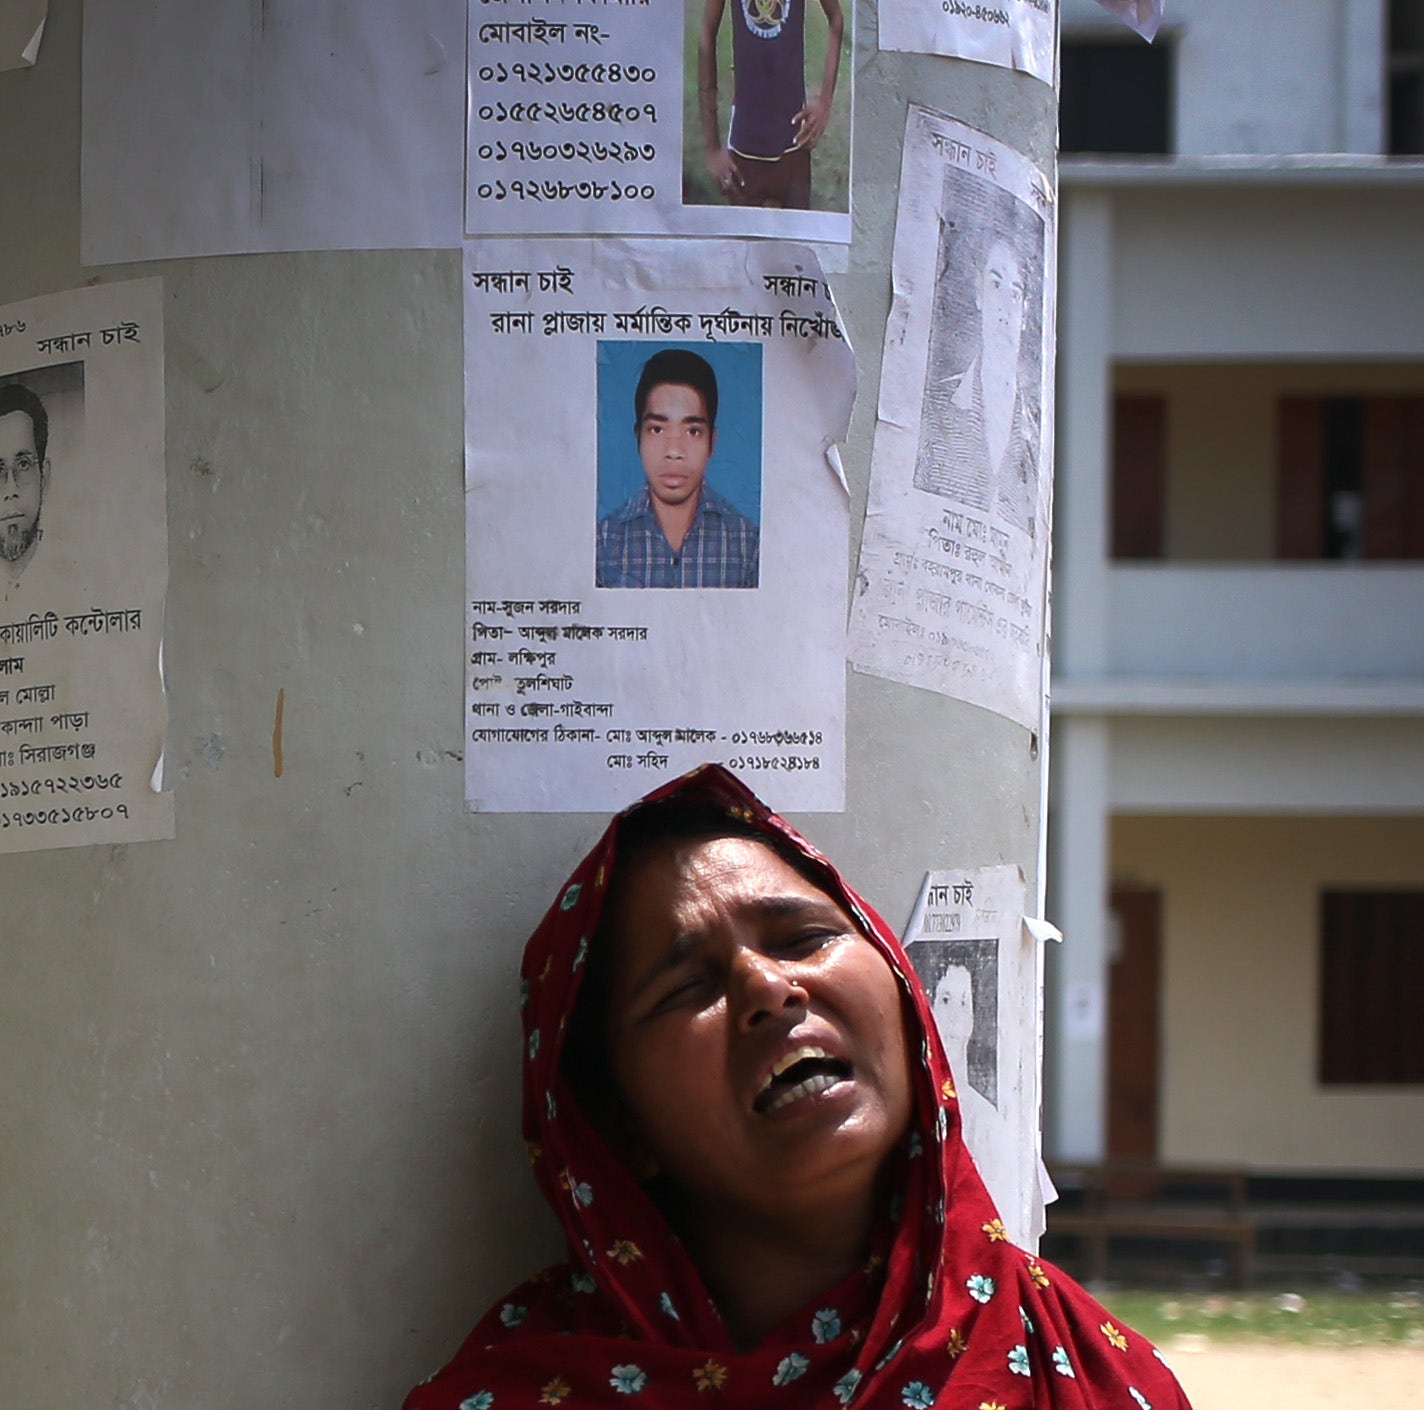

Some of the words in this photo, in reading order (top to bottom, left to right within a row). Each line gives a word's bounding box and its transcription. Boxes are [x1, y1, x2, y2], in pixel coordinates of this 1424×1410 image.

[478, 16, 567, 45] মোবাইল
[573, 23, 610, 45] নং-
[478, 62, 657, 85] ০১৭২১৩৫৫৪৩০
[478, 101, 658, 125] ০১৫৫২৬৫৪৫০৭
[478, 141, 656, 164] ০১৭৬০৩২৬২৯৩
[478, 180, 655, 202] ০১৭২৬৮৩৮১০০
[472, 270, 531, 294] সন্ধান
[537, 265, 575, 294] চাই
[763, 274, 819, 298] সন্ধান
[490, 311, 535, 334] রানা
[542, 311, 608, 336] প্লাজায়
[613, 305, 692, 334] মর্মান্তিক
[699, 306, 774, 342] দূর্ঘটনায়
[36, 332, 92, 355] সন্ধান
[100, 321, 141, 346] চাই
[539, 600, 581, 615] সরদার
[608, 627, 648, 641] সরদার
[471, 651, 503, 666] গ্রাম-
[15, 684, 56, 705] মোল্লা
[514, 673, 574, 695] তুলশিঘাট
[50, 711, 90, 732] পাড়া
[472, 703, 500, 717] থানা
[505, 704, 516, 718] ও
[472, 729, 549, 744] যোগাযোগের
[606, 730, 632, 744] মোঃ
[675, 728, 717, 744] মালেক
[19, 743, 97, 765] সিরাজগঞ্জ
[607, 753, 633, 769] মোঃ
[637, 751, 669, 769] সহিদ
[952, 878, 974, 908] চাই
